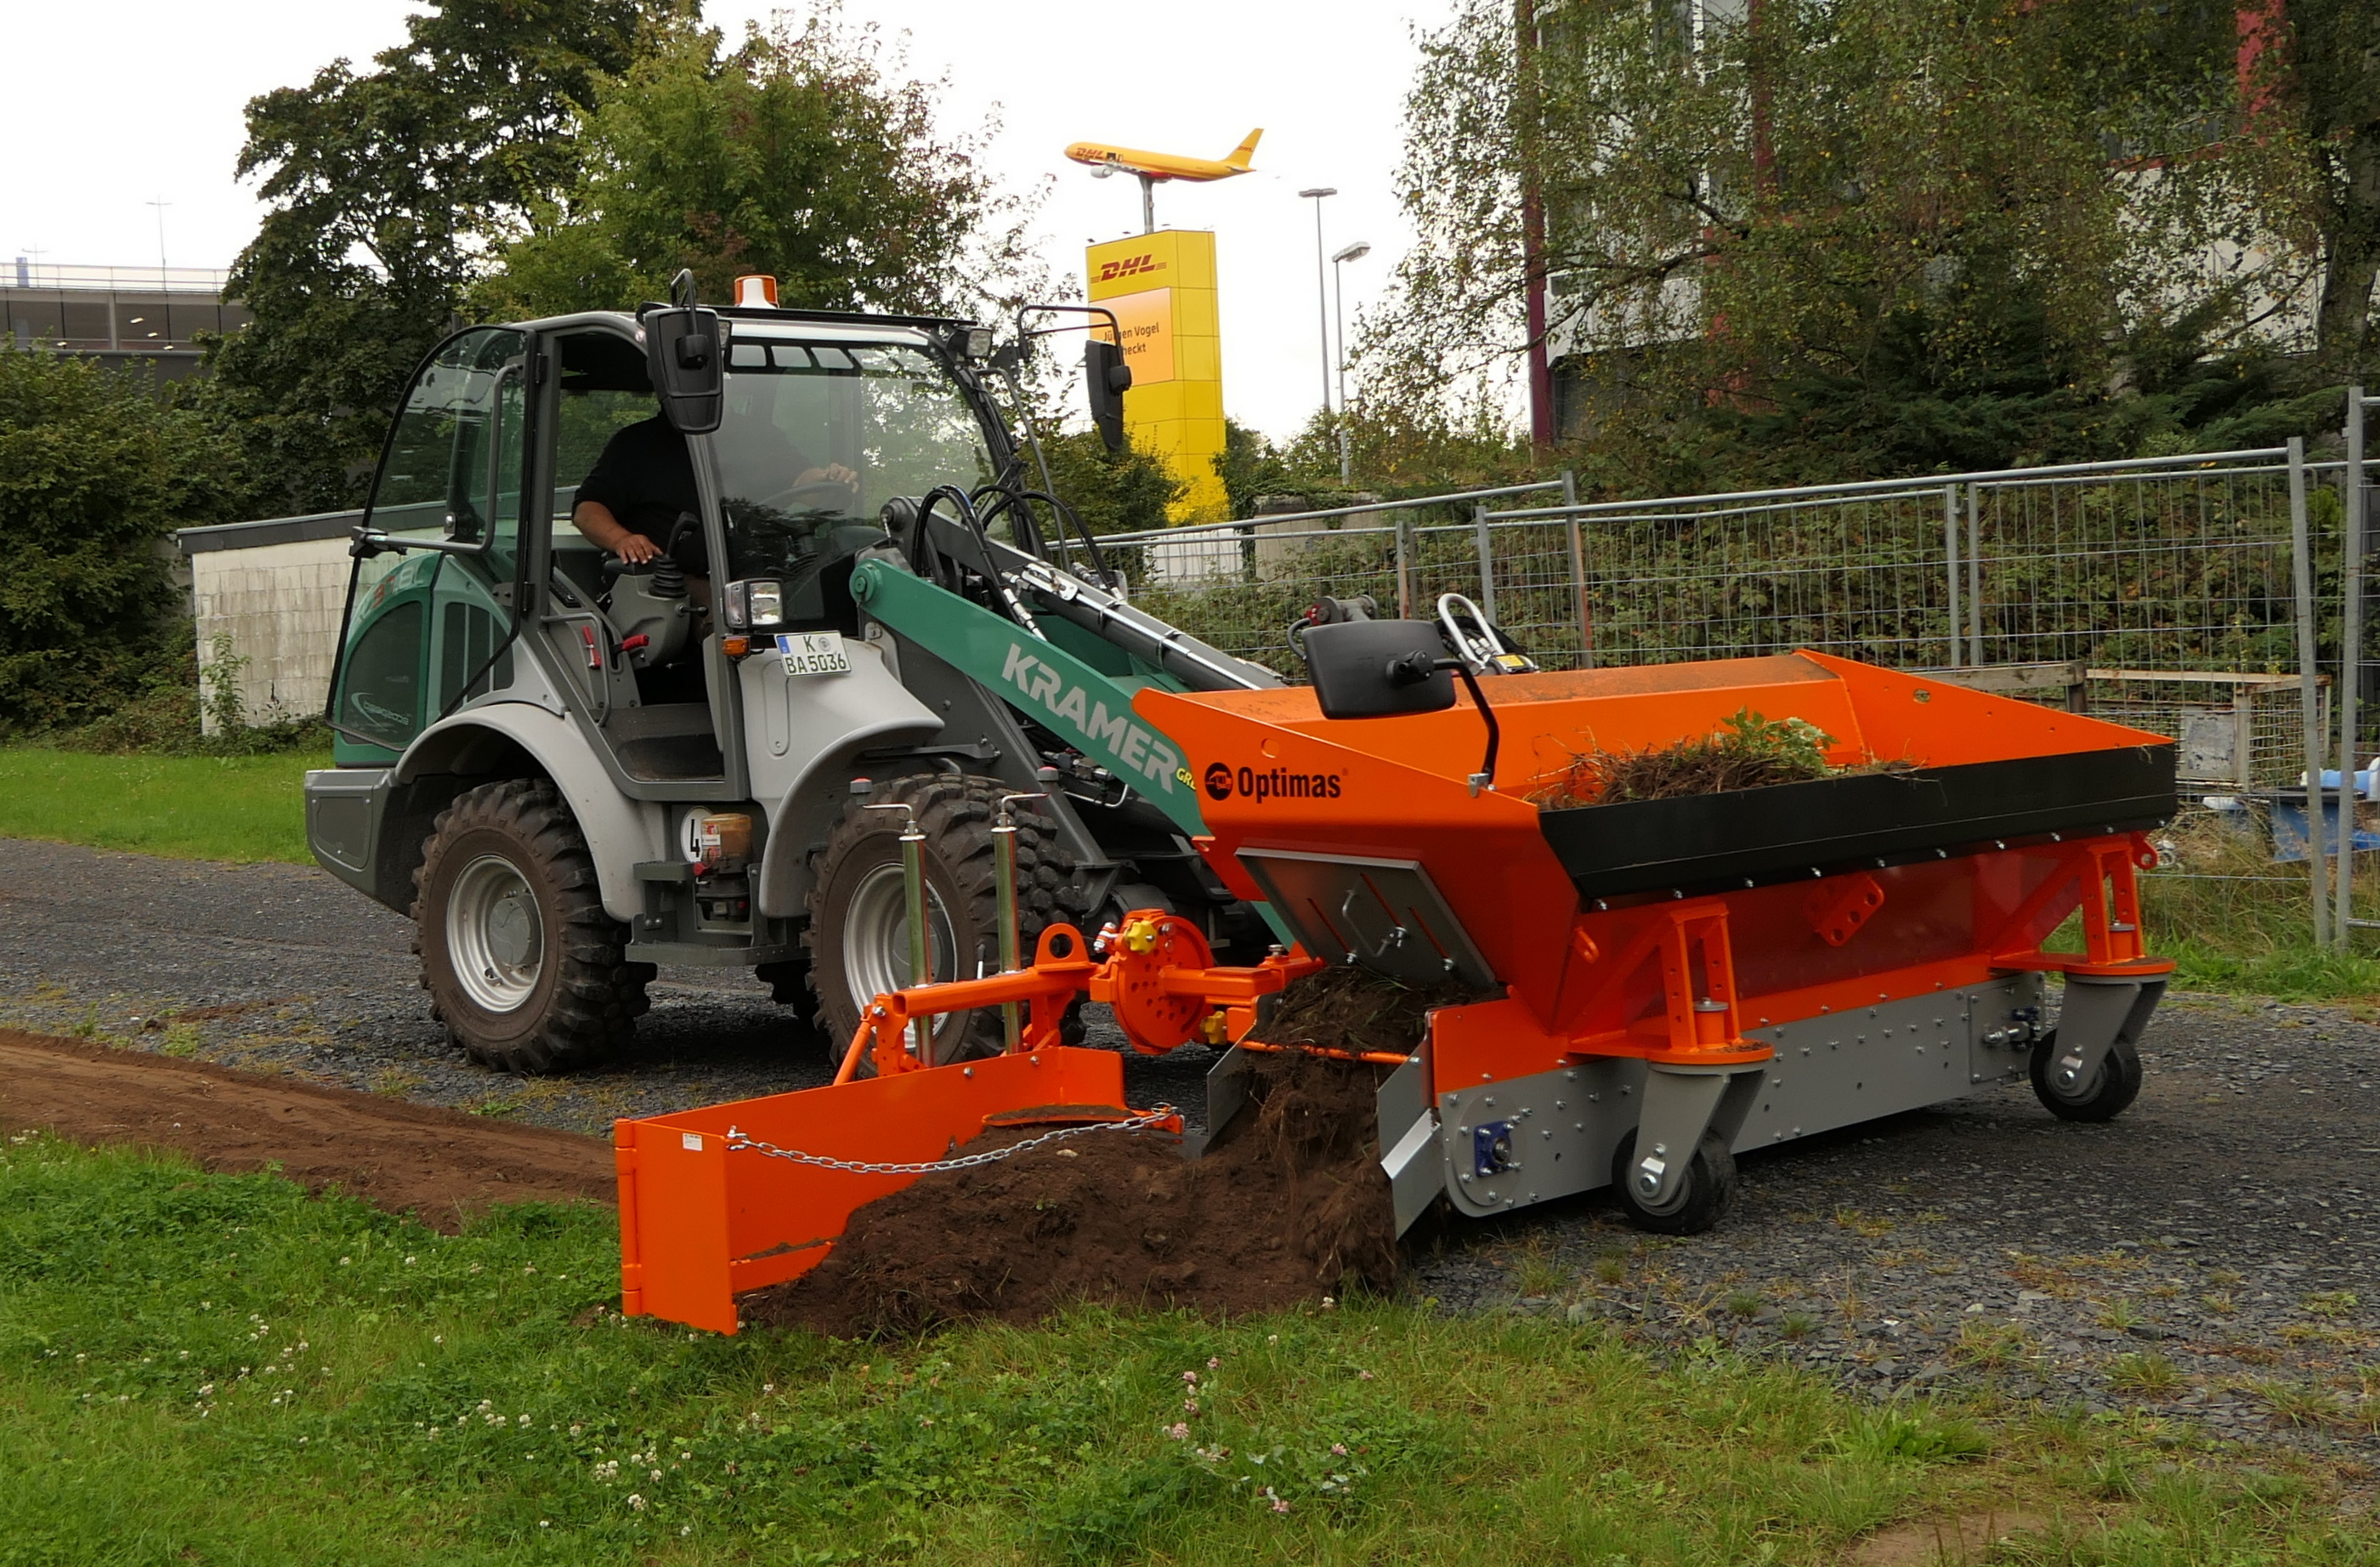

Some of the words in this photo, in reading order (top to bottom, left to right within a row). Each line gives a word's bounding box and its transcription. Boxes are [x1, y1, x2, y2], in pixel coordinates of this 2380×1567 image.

[1075, 147, 1104, 160] DHL
[1100, 254, 1156, 282] DHL
[1103, 331, 1133, 342] Jüen
[1134, 322, 1159, 338] Vogel
[1121, 343, 1147, 356] heckt
[802, 635, 816, 653] K
[785, 656, 808, 673] BA
[808, 654, 846, 672] 5036
[1001, 643, 1179, 795] KRAMER
[1238, 766, 1341, 804] Optimas
[690, 819, 700, 858] 4
